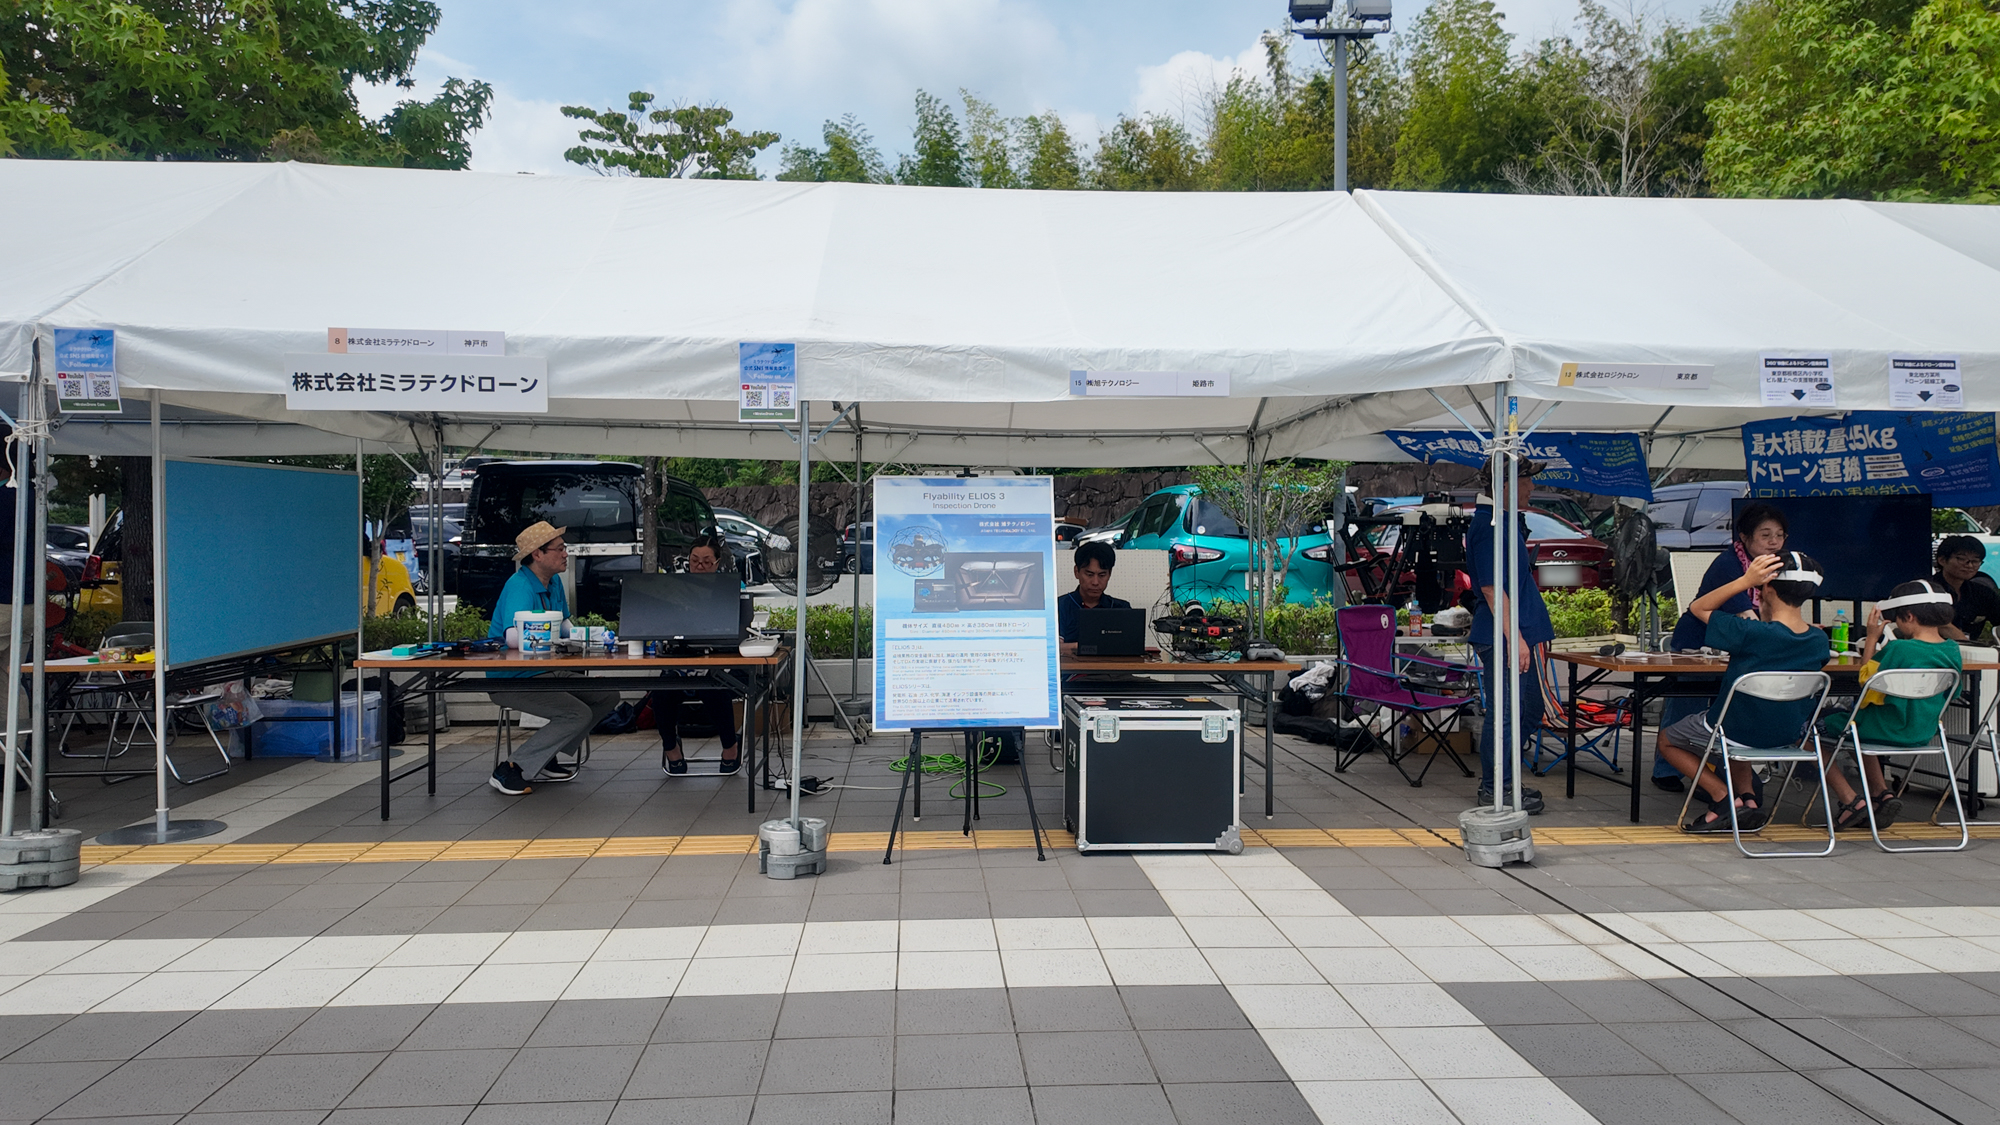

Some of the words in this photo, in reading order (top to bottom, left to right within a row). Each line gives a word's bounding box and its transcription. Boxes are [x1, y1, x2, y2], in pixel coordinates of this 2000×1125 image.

[347, 337, 435, 347] 株式会社ミラテクドローン
[464, 339, 488, 348] 神戸市
[1675, 372, 1698, 381] 東京都
[292, 372, 539, 393] 株式会社ミラテクドローン
[1192, 379, 1215, 388] 姫路市
[1751, 456, 1863, 483] ドローン運搬
[923, 492, 966, 501] Flyability
[968, 492, 996, 500] ELIOS
[998, 492, 1005, 500] 3
[932, 502, 972, 510] Inspection
